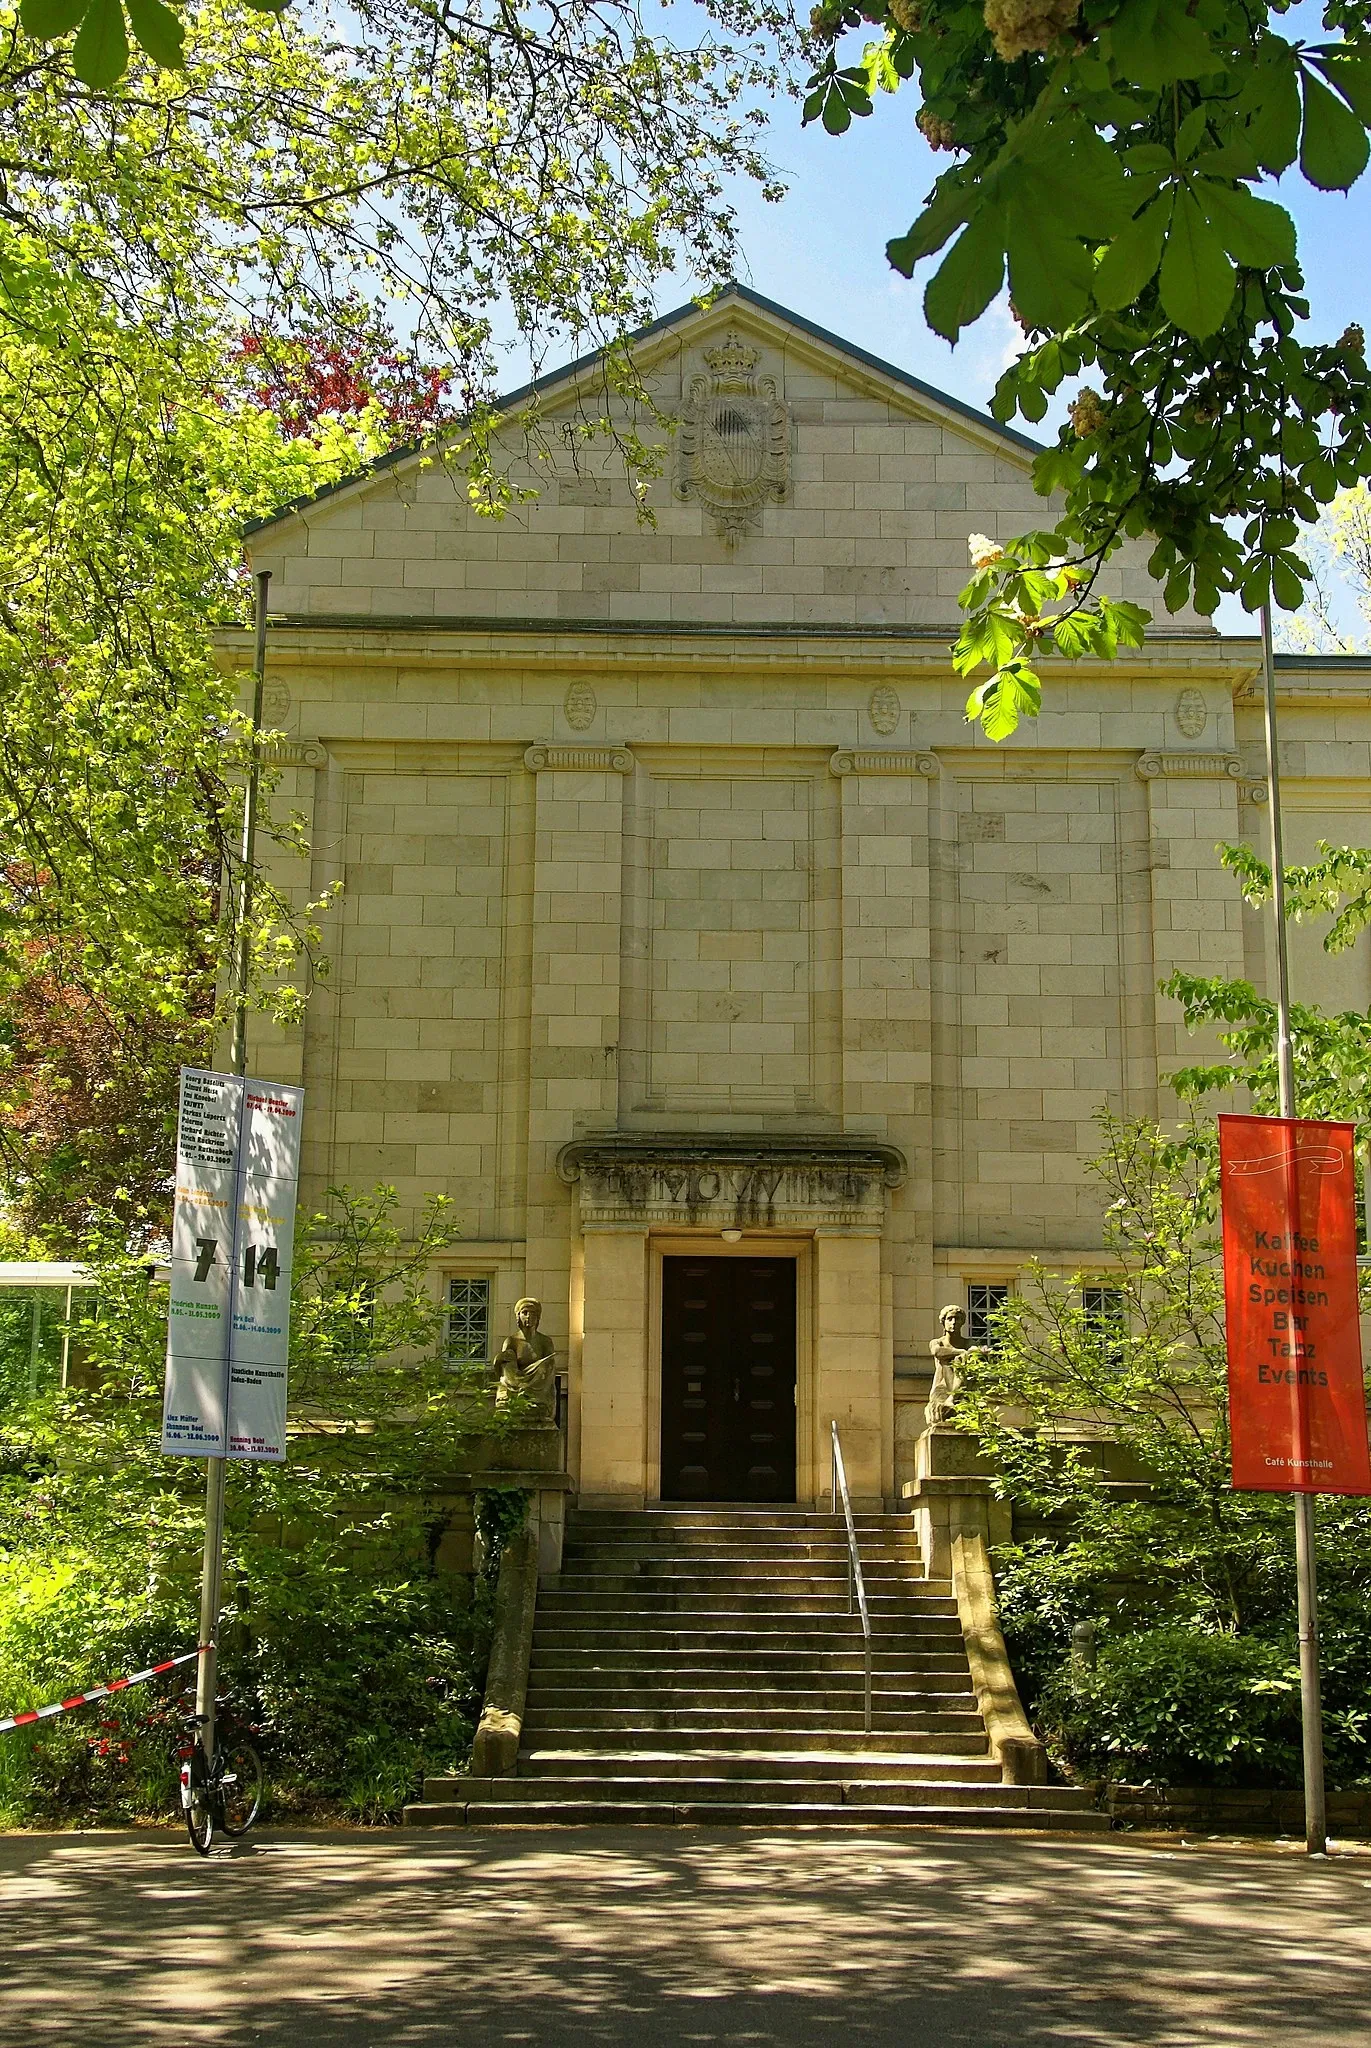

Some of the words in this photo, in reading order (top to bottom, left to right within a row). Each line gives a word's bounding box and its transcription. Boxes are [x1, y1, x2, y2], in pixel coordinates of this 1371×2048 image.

[186, 1074, 201, 1084] Georg
[185, 1083, 202, 1092] Almut
[194, 1093, 216, 1102] Knoebel
[183, 1108, 202, 1118] Markus
[182, 1116, 203, 1126] Palermo
[182, 1125, 202, 1134] Gerhard
[204, 1129, 226, 1138] Richter
[181, 1134, 196, 1142] Ulrich
[1256, 1231, 1319, 1252] Kaffee
[194, 1238, 218, 1282] 7
[244, 1244, 280, 1290] 14
[1251, 1258, 1324, 1280] Kuchen
[1250, 1284, 1328, 1306] Speisen
[1274, 1312, 1309, 1331] Bar
[1268, 1338, 1316, 1358] Tanz
[231, 1376, 262, 1384] Baden-Baden
[255, 1370, 284, 1378] Kunsthalle
[1258, 1365, 1328, 1386] Events
[1265, 1457, 1285, 1467] Café
[1287, 1458, 1333, 1469] Kunsthalle
